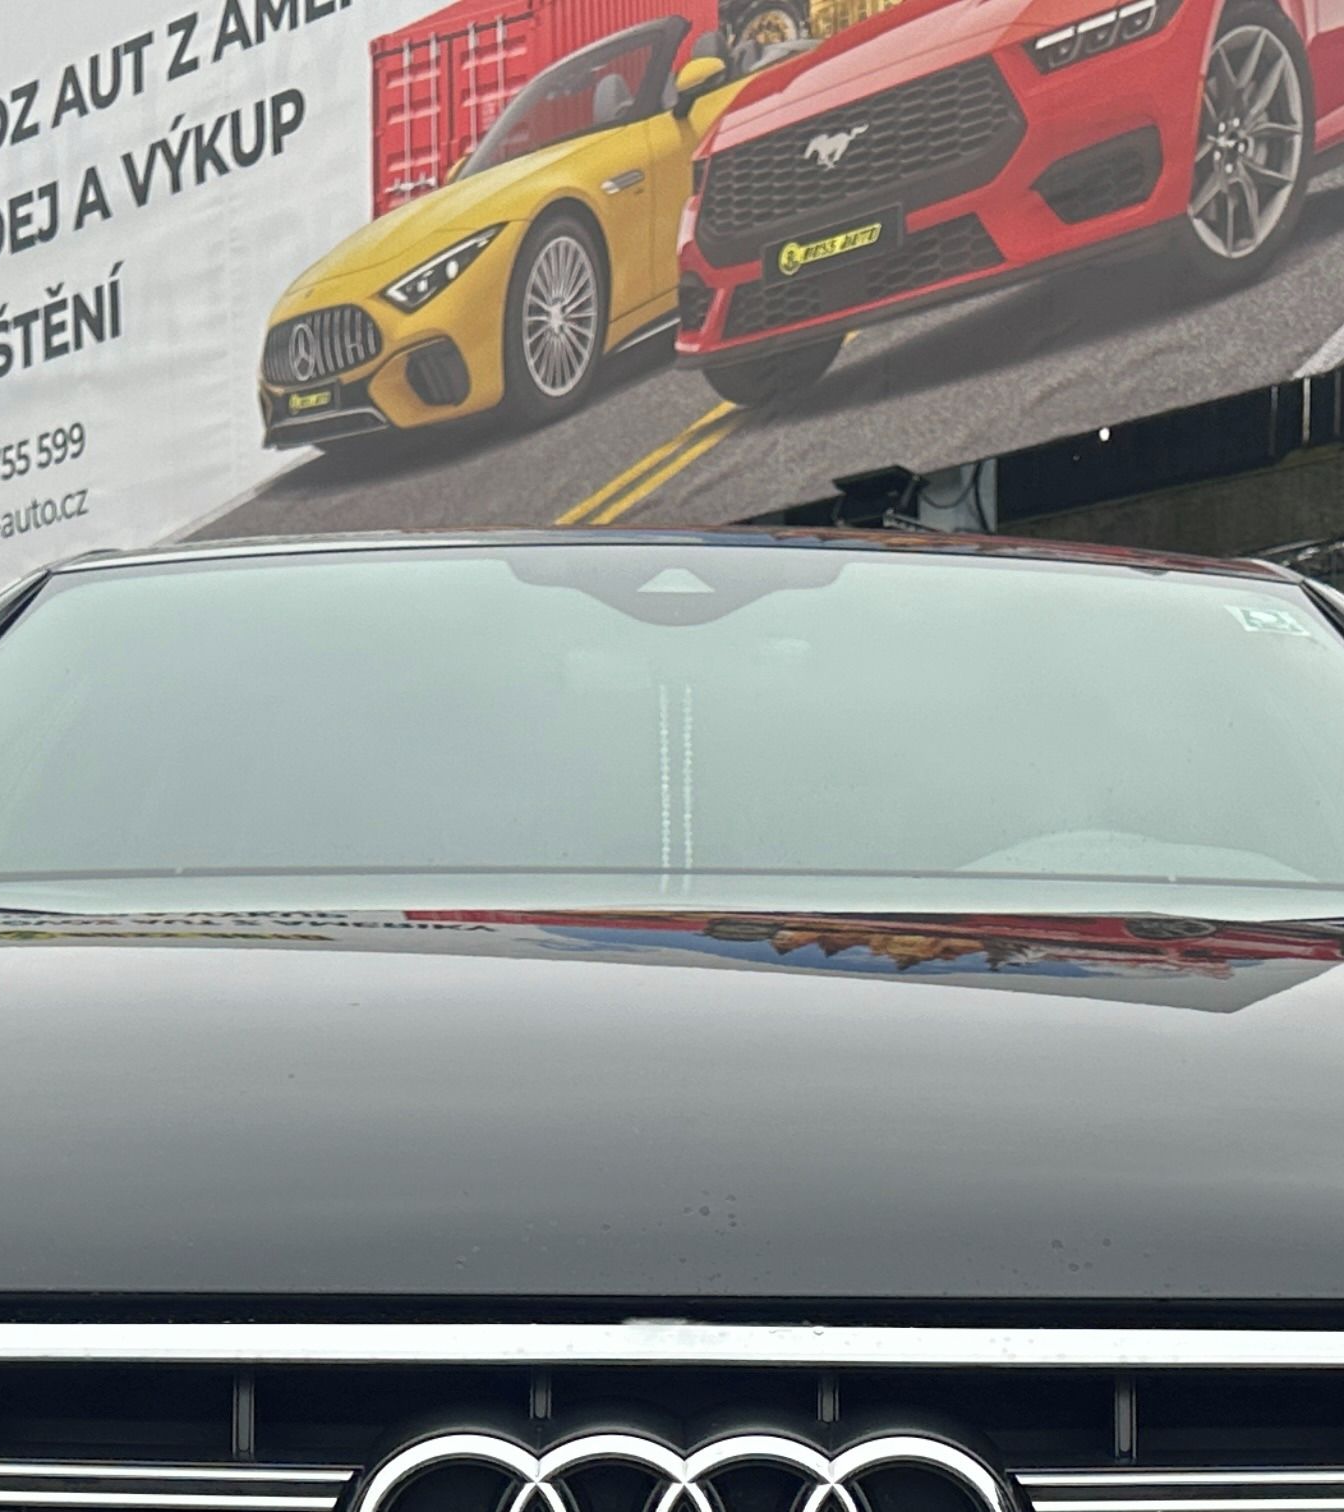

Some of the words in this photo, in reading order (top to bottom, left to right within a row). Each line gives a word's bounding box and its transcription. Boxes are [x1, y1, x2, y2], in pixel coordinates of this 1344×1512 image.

[51, 31, 155, 129] AUT
[166, 13, 200, 82] Z
[73, 167, 113, 231] A
[121, 88, 306, 208] VÝKUP
[36, 422, 86, 469] 599
